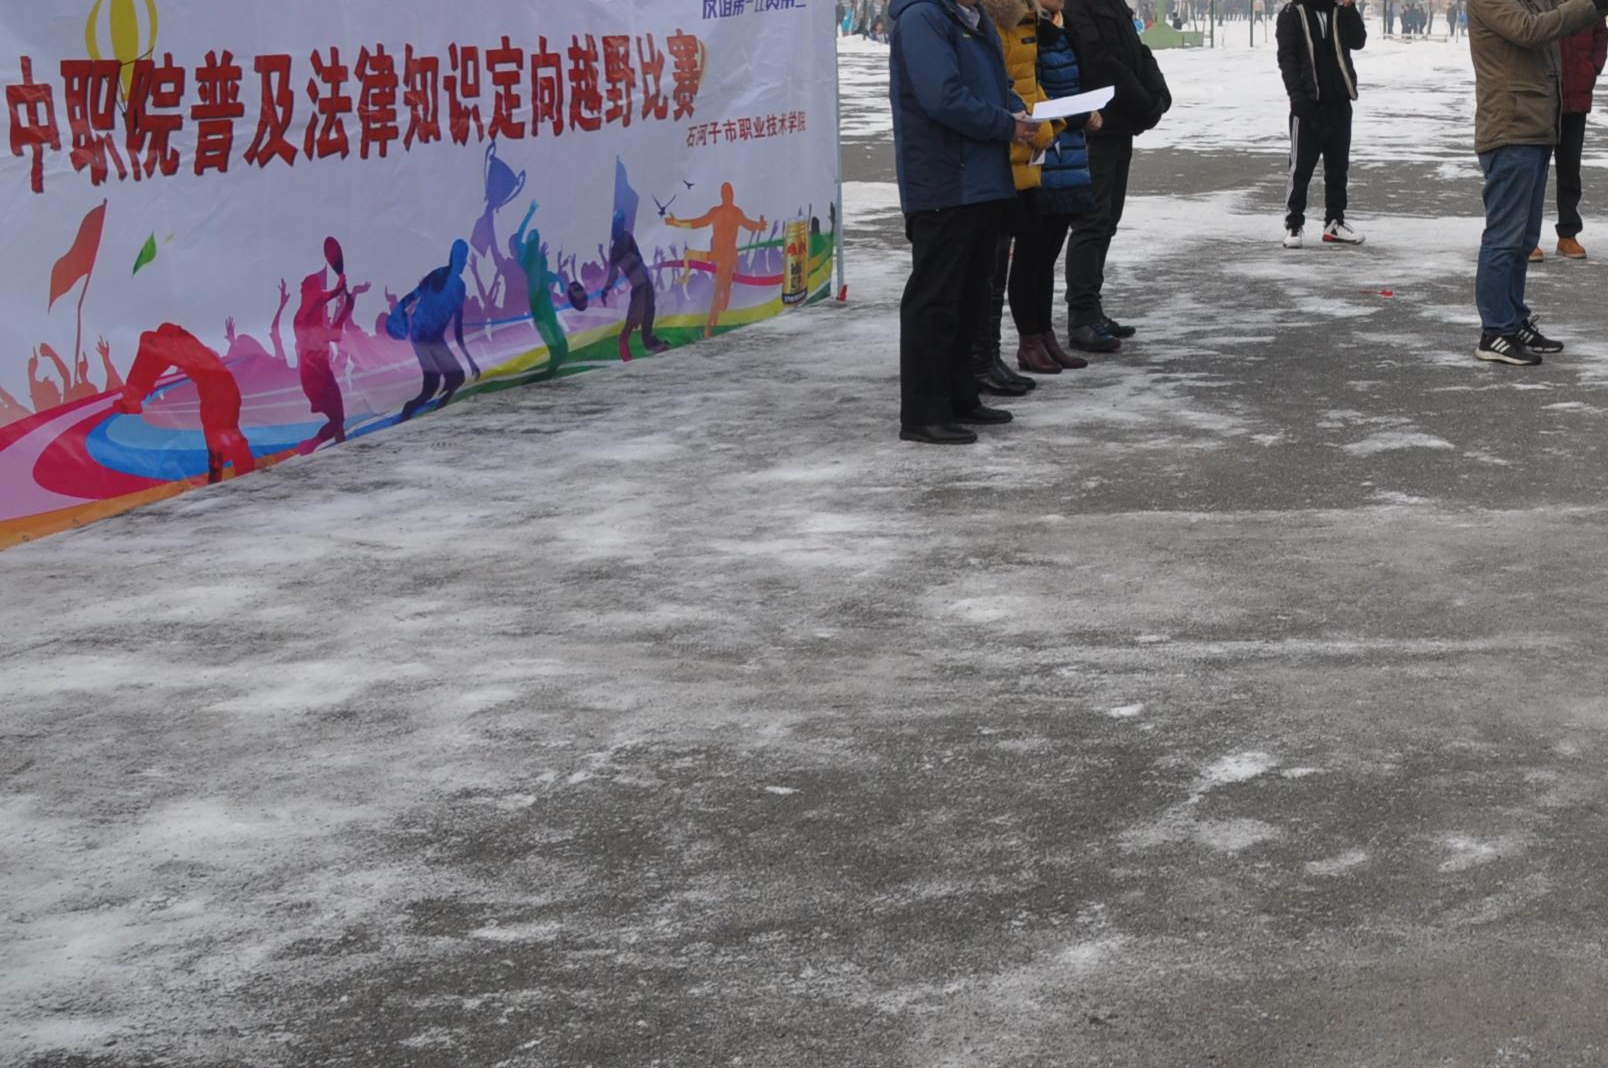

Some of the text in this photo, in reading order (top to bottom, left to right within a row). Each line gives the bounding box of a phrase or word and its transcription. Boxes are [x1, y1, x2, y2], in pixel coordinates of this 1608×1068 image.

[6, 29, 704, 194] 中职院普及法律知识定向越野比赛
[686, 111, 806, 148] 石河子市职业技术学院
